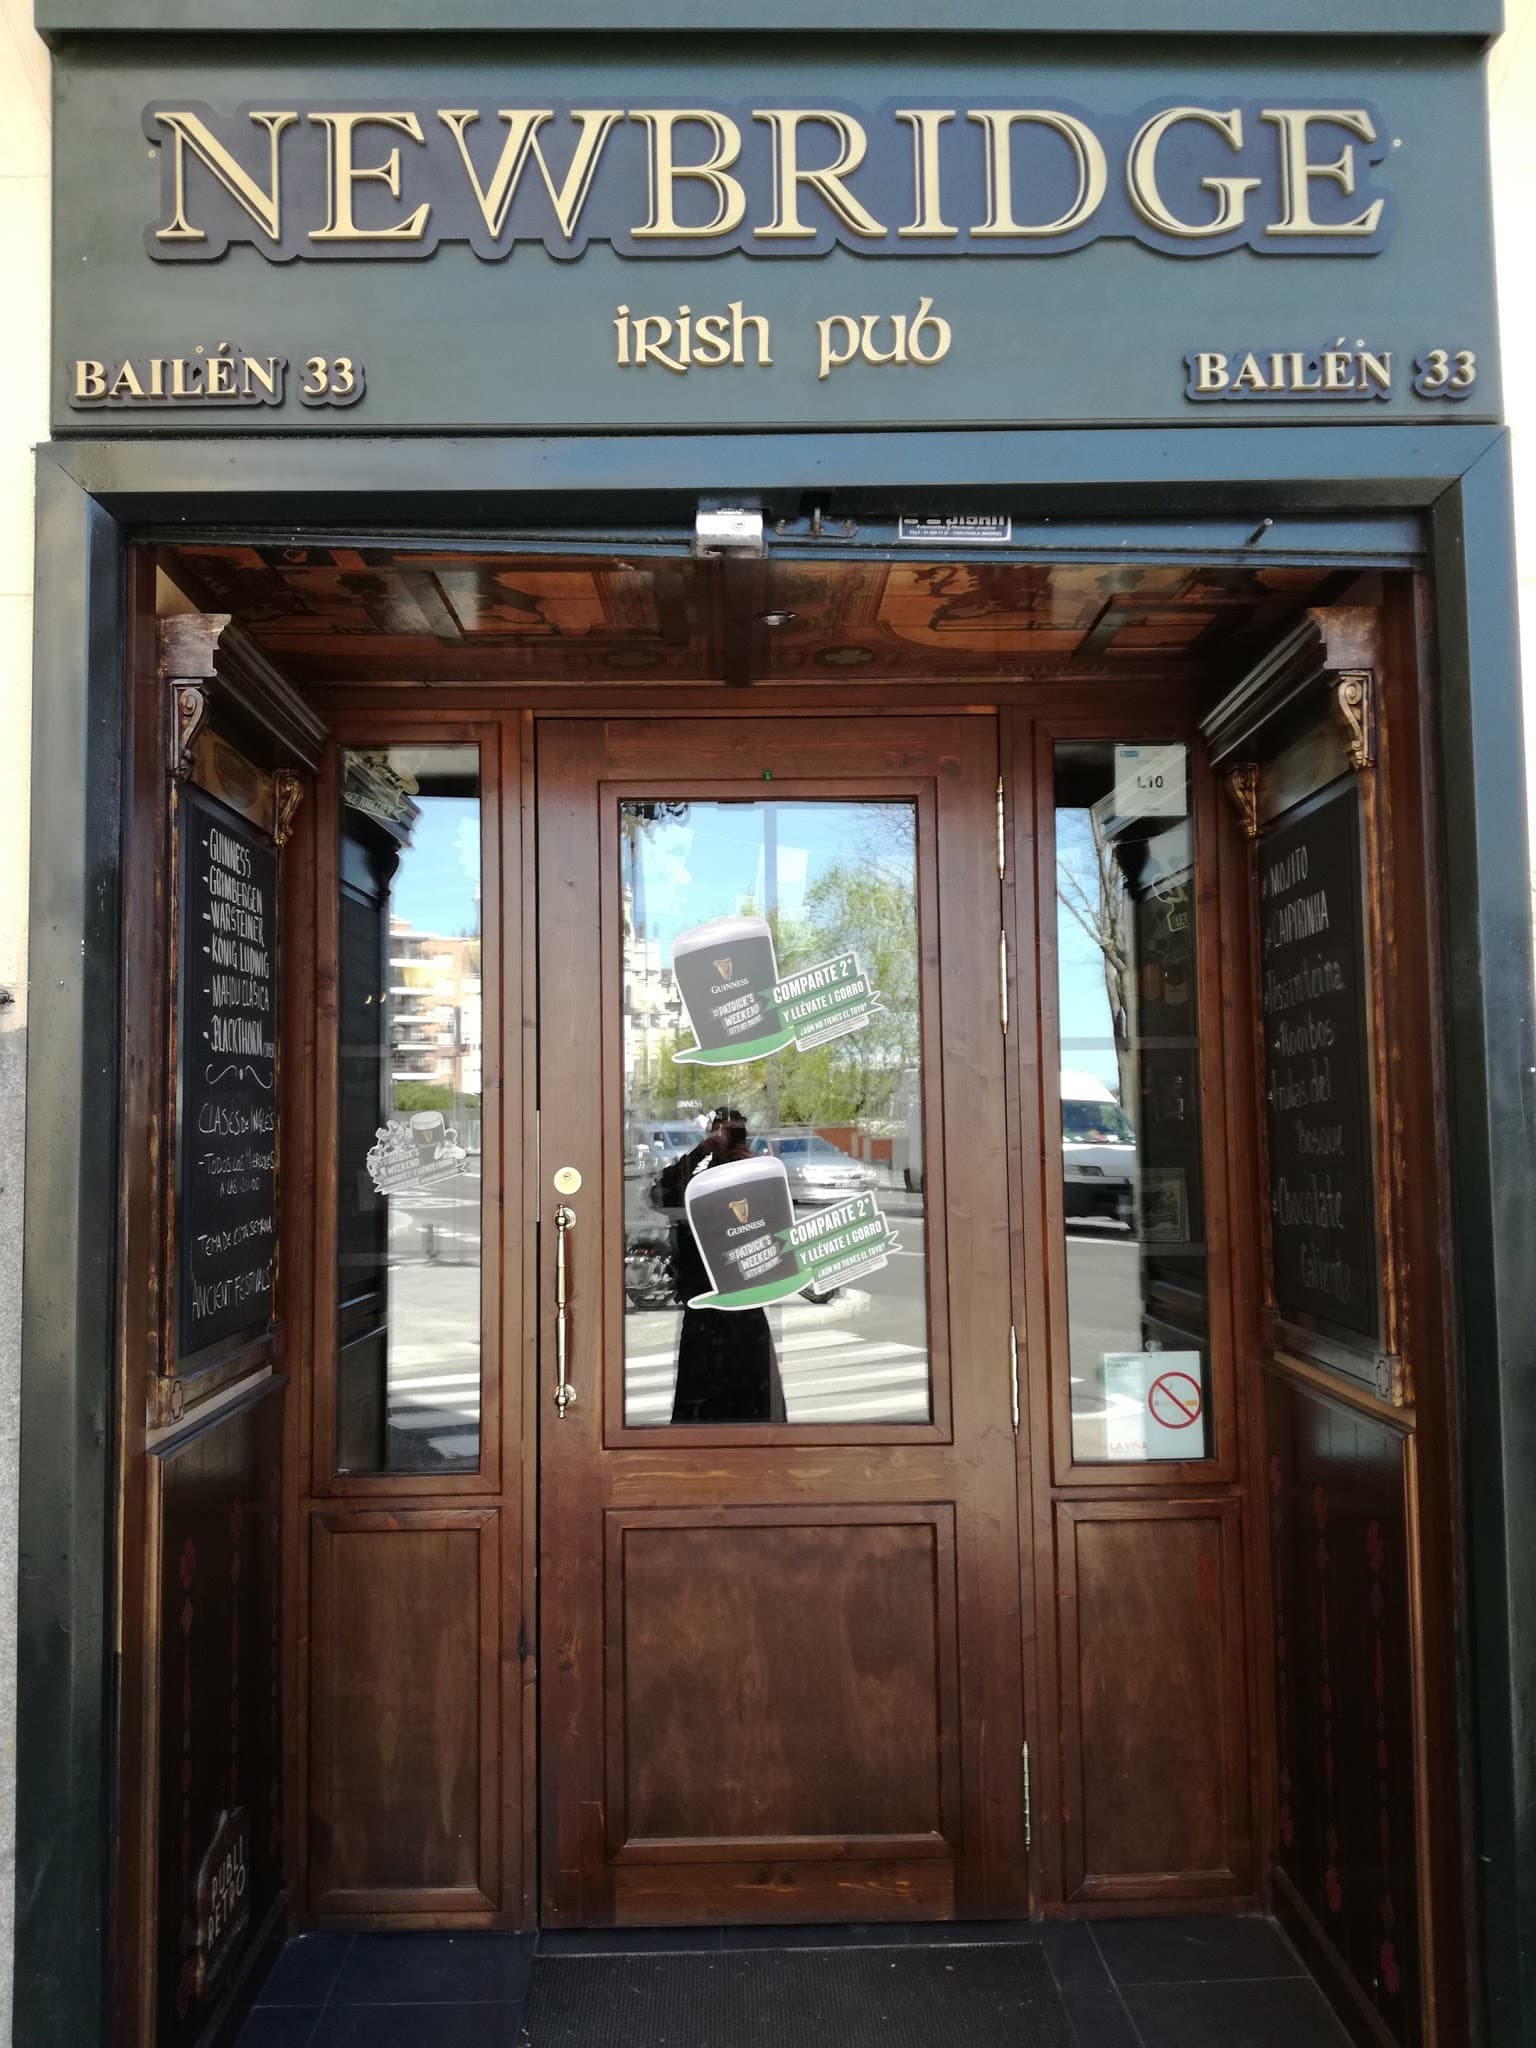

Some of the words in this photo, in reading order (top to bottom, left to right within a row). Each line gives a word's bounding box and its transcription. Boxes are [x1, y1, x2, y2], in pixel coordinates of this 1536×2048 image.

[154, 107, 1384, 241] NEWBRIDGE
[817, 297, 953, 381] pub
[74, 344, 279, 398] BAILÉN
[304, 357, 356, 397] 33
[1195, 337, 1393, 392] BAILÉN
[1425, 350, 1478, 389] 33
[210, 827, 250, 879] GUINNESS
[1270, 845, 1309, 897] MOJITO
[209, 864, 263, 914] GRIMBERGEN
[210, 900, 264, 948] WARSTEINER
[240, 940, 269, 979] LUDWIG
[711, 977, 750, 995] GUINNESS
[719, 993, 756, 1017] PATRICK'S
[773, 965, 838, 1004] COMPARTE
[782, 1010, 791, 1023] Y
[791, 993, 828, 1021] LLÉVATE
[834, 980, 865, 1003] GORRO
[210, 1014, 263, 1054] BLACKTHORN
[725, 1003, 761, 1028] WEEKEND
[824, 1014, 843, 1027] TIENES
[198, 1102, 240, 1137] CLASES
[726, 1218, 766, 1237] GUINNESS
[789, 1203, 856, 1246] COMPARTE
[800, 1250, 808, 1265] Y
[808, 1235, 846, 1262] LLÉVATE
[851, 1220, 882, 1243] GORRO
[735, 1234, 772, 1259] PATRICK'S
[741, 1245, 777, 1270] WEEKEND
[842, 1255, 861, 1269] TIENES
[191, 1277, 233, 1323] ANCIENT
[207, 1864, 246, 1951] RETRO
